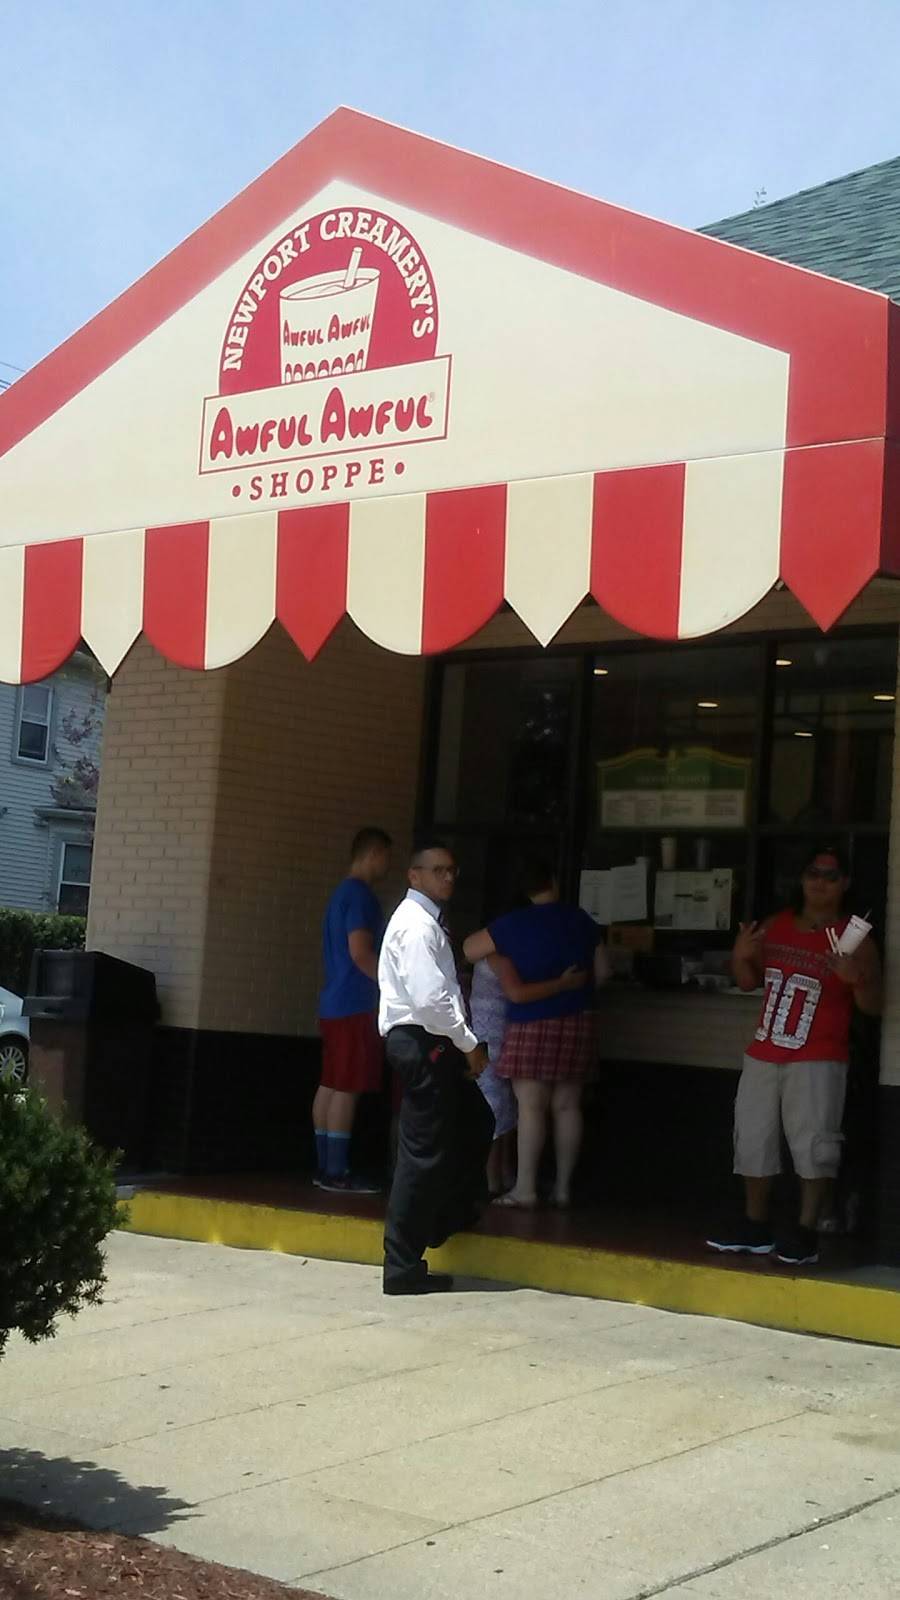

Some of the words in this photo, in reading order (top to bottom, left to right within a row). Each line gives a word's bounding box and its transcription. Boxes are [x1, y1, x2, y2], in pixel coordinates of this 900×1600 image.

[223, 224, 311, 371] NEWPORT
[319, 211, 435, 338] CREAMERY'S
[284, 320, 324, 347] AWFUL
[210, 407, 313, 461] AWFUL
[320, 387, 433, 444] AWFUL
[250, 458, 385, 500] SHOPPE
[754, 967, 823, 1050] 10
